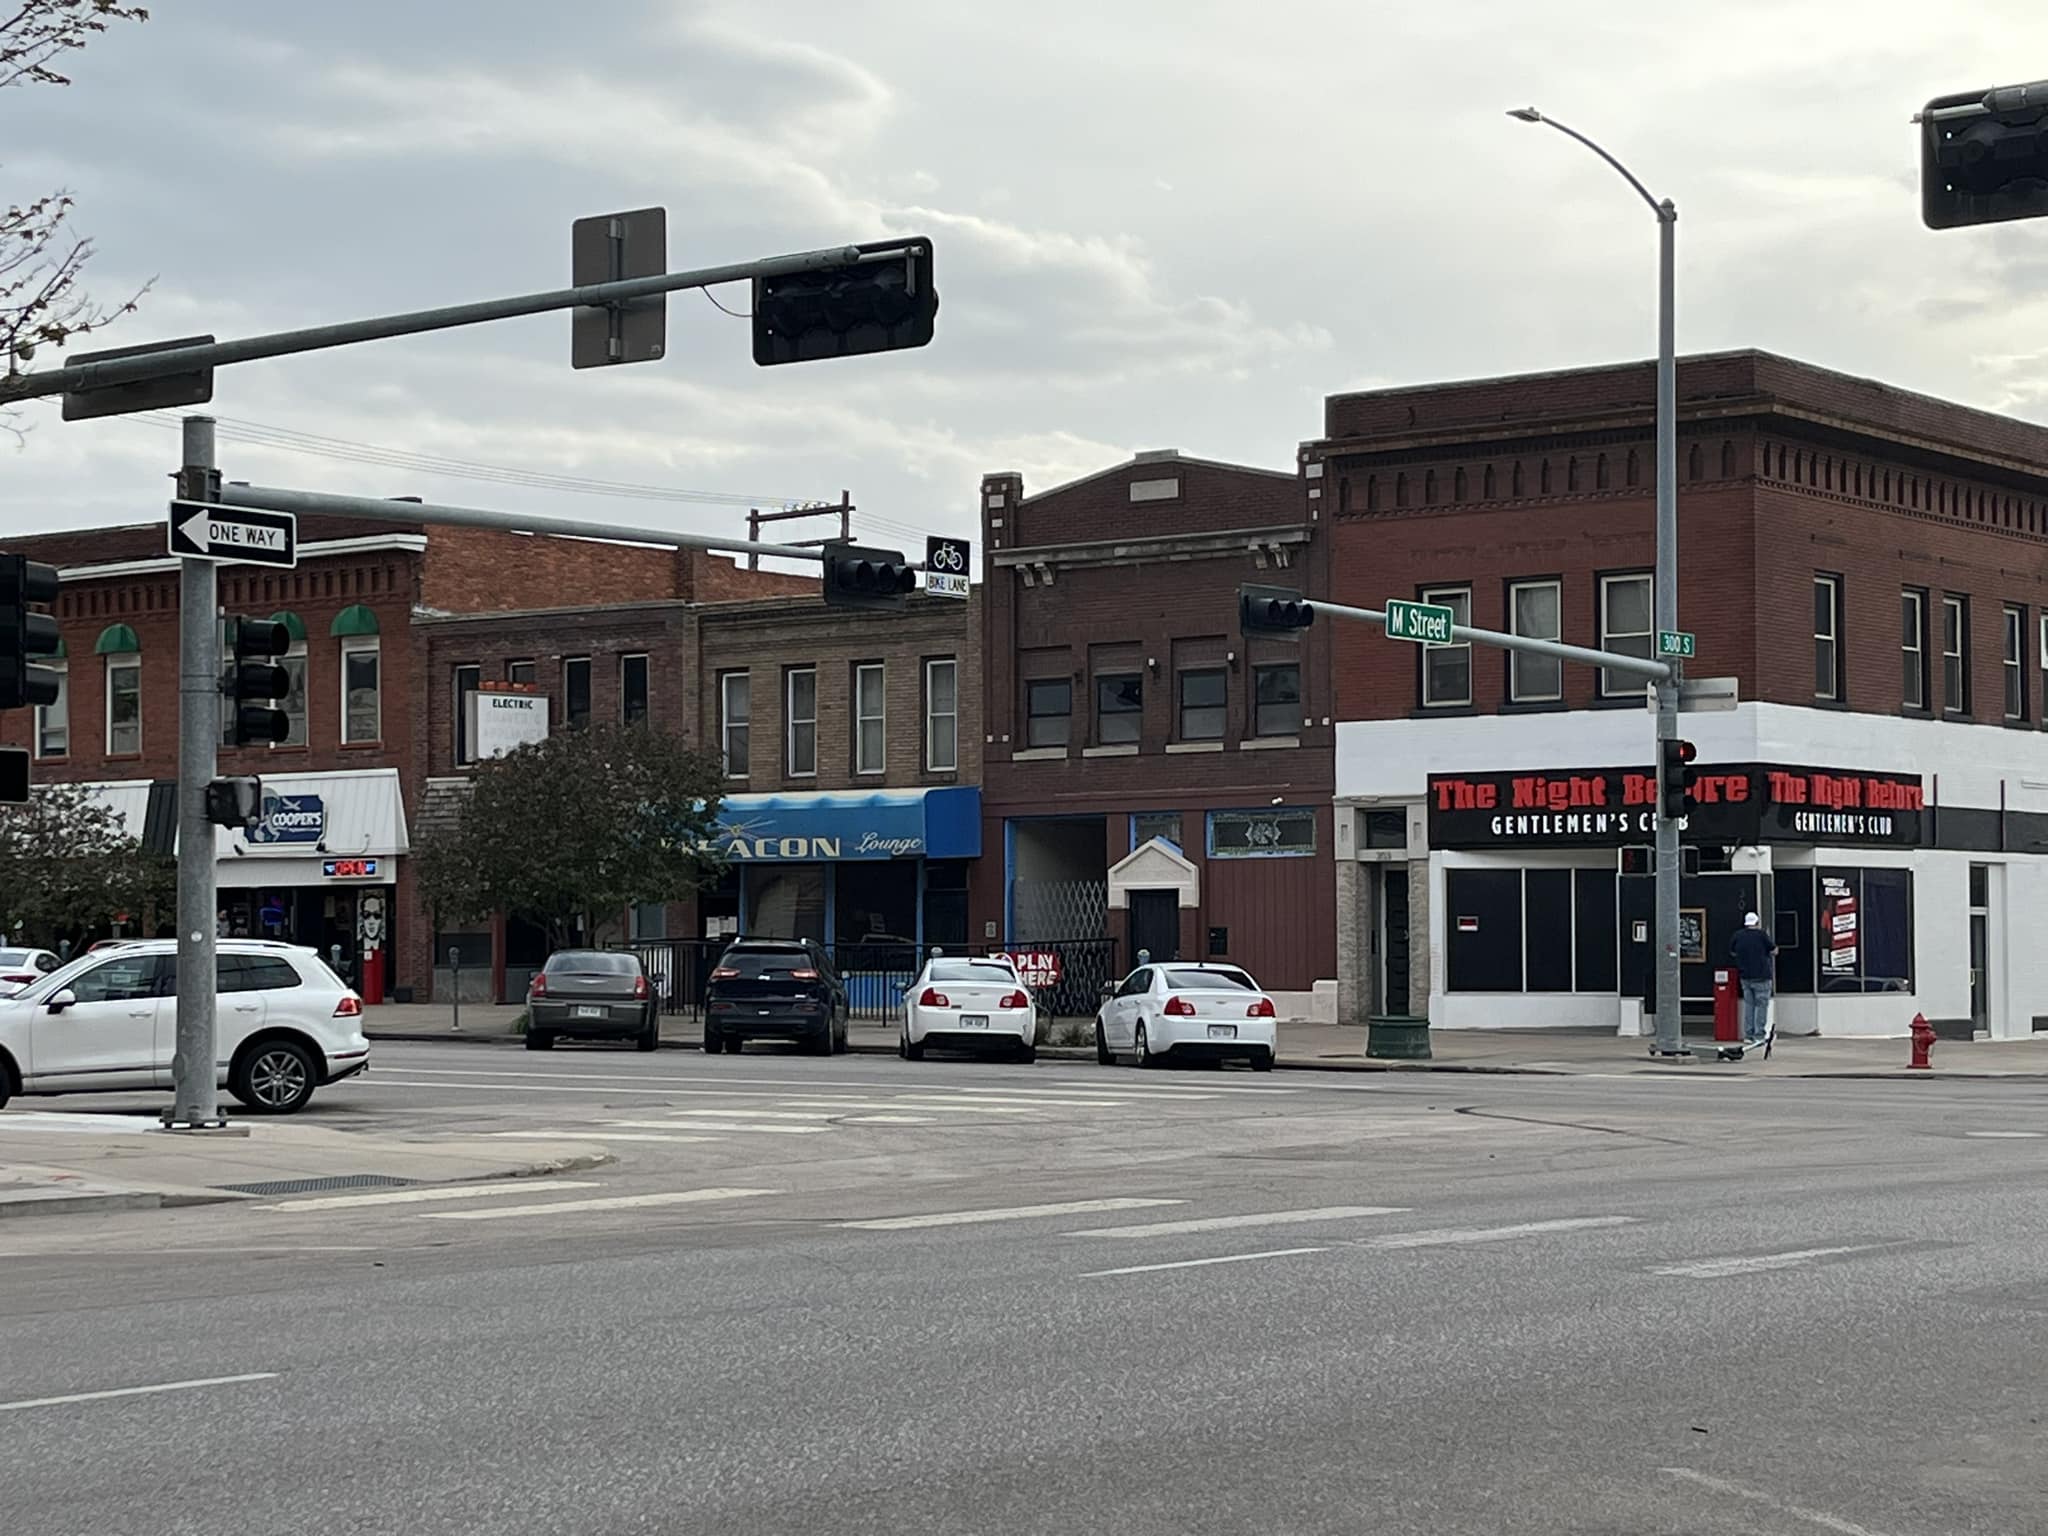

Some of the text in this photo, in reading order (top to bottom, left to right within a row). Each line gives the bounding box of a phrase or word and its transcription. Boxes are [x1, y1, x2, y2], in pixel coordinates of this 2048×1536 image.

[209, 523, 276, 547] ONE WAY
[929, 575, 968, 593] BIKE LANE
[1392, 606, 1447, 639] M Street
[1663, 634, 1690, 654] 300 S
[492, 698, 533, 710] ELECTRIC
[1433, 779, 1496, 810] The
[1512, 776, 1606, 811] Night
[1769, 772, 1925, 811] The Night Before
[1491, 813, 1629, 835] GENTLEMEN'S
[1795, 811, 1893, 836] GENTLEMEN'S CLUB
[662, 831, 922, 858] EACON Lounge
[335, 860, 366, 876] OPEN
[1017, 953, 1053, 970] PLAY
[1018, 970, 1058, 987] HERE
